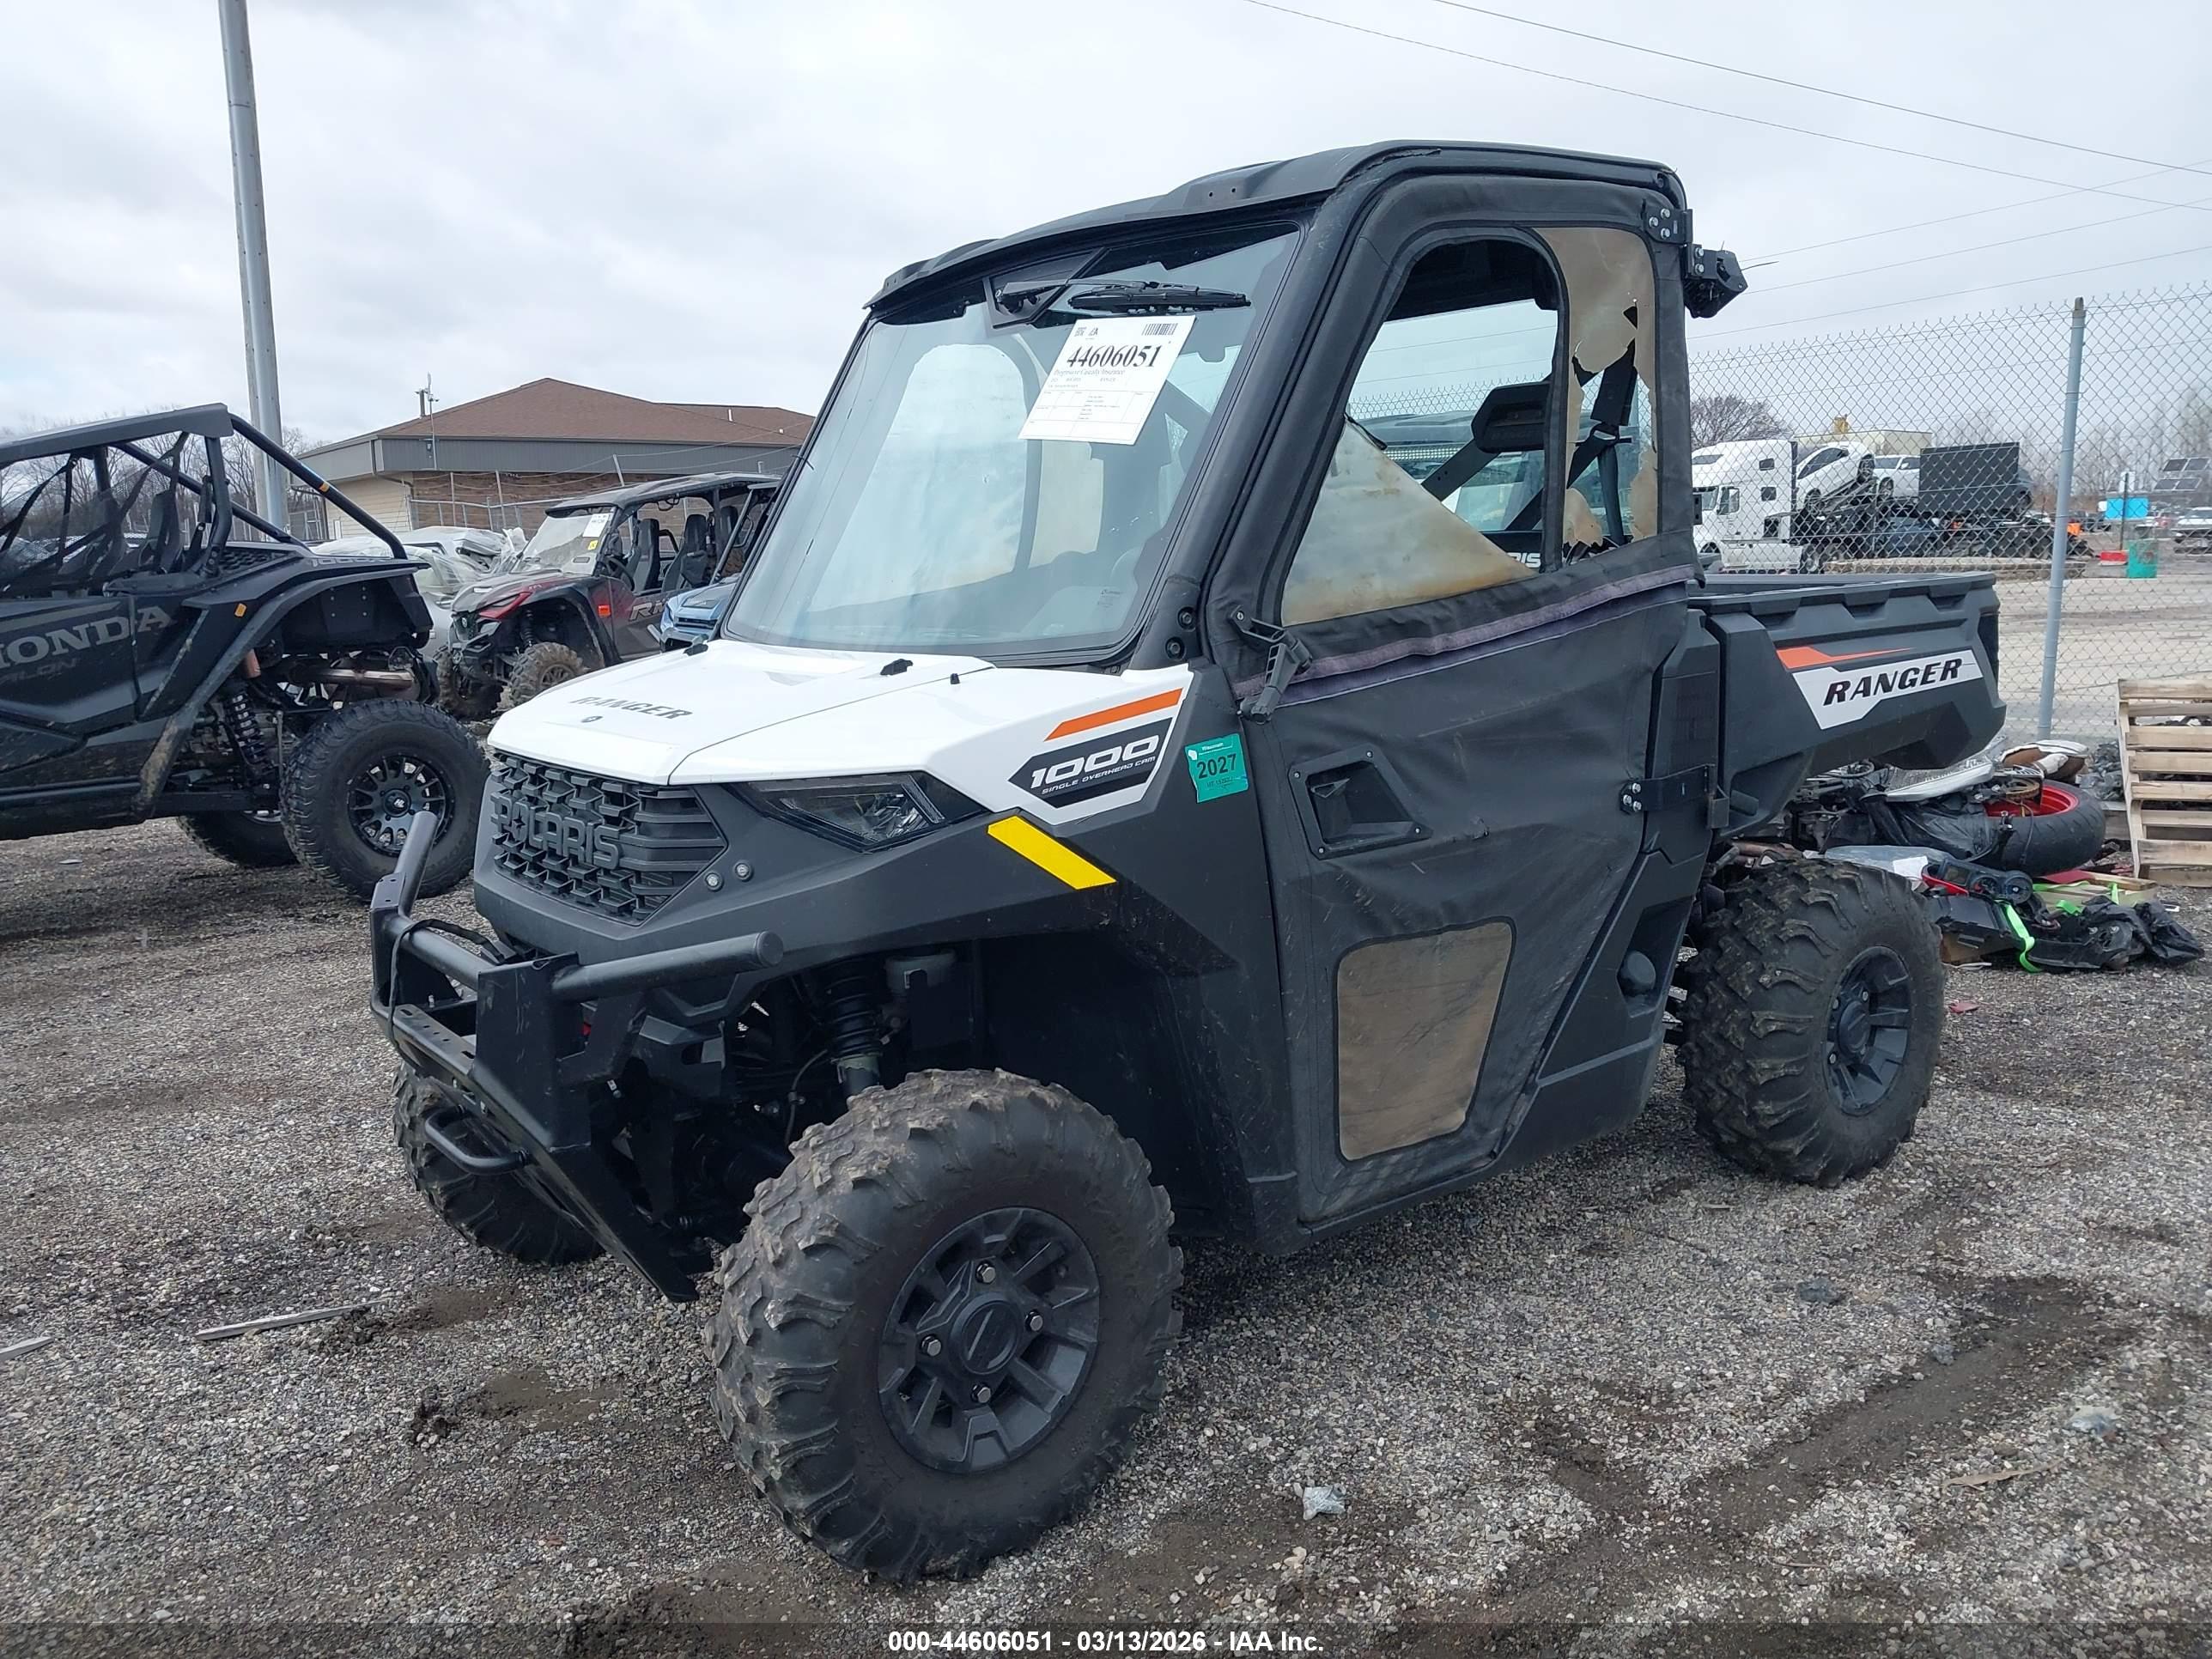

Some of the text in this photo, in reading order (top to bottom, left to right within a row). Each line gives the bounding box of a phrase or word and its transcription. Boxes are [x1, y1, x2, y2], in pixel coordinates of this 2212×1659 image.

[1066, 345, 1163, 368] 44606051
[1822, 658, 1963, 707] RANGER
[568, 696, 693, 720] RANGER
[1030, 734, 1160, 789] 1000
[1042, 756, 1157, 795] SINGLE OVERHEAD CAM
[1196, 753, 1237, 779] 2027
[490, 792, 619, 870] POLARIS
